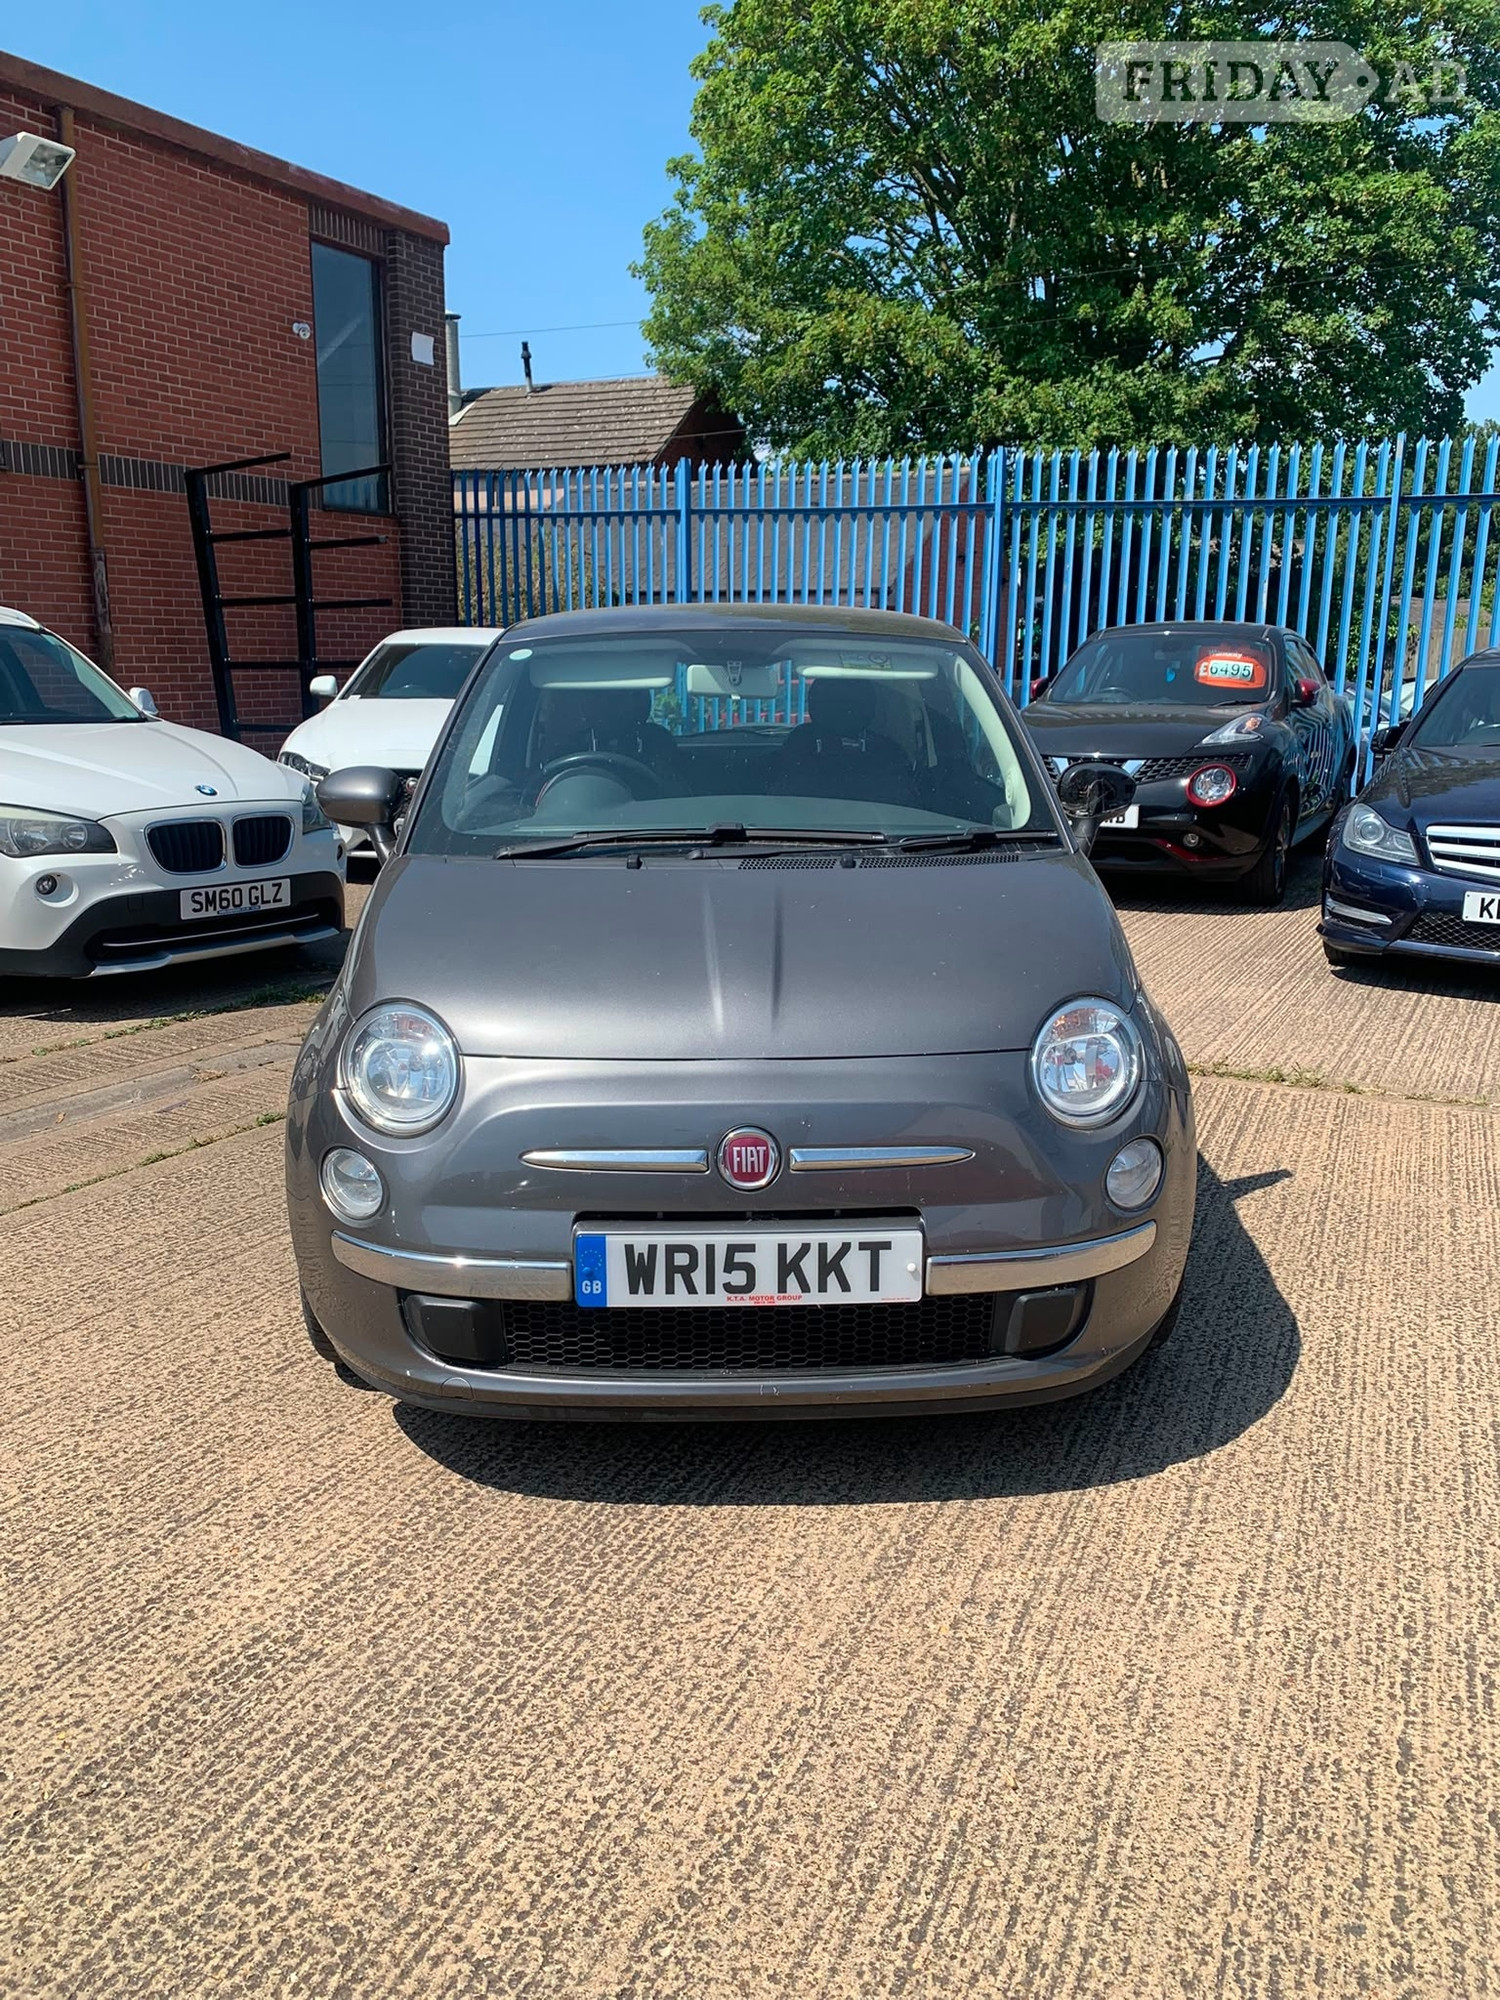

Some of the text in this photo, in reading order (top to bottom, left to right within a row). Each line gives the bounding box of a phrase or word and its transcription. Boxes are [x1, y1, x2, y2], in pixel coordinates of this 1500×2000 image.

[190, 882, 283, 913] SM60 GLZ
[1479, 897, 1500, 919] K
[732, 1146, 767, 1173] FIAT
[624, 1241, 892, 1295] WR15 KKT
[581, 1280, 602, 1294] GB
